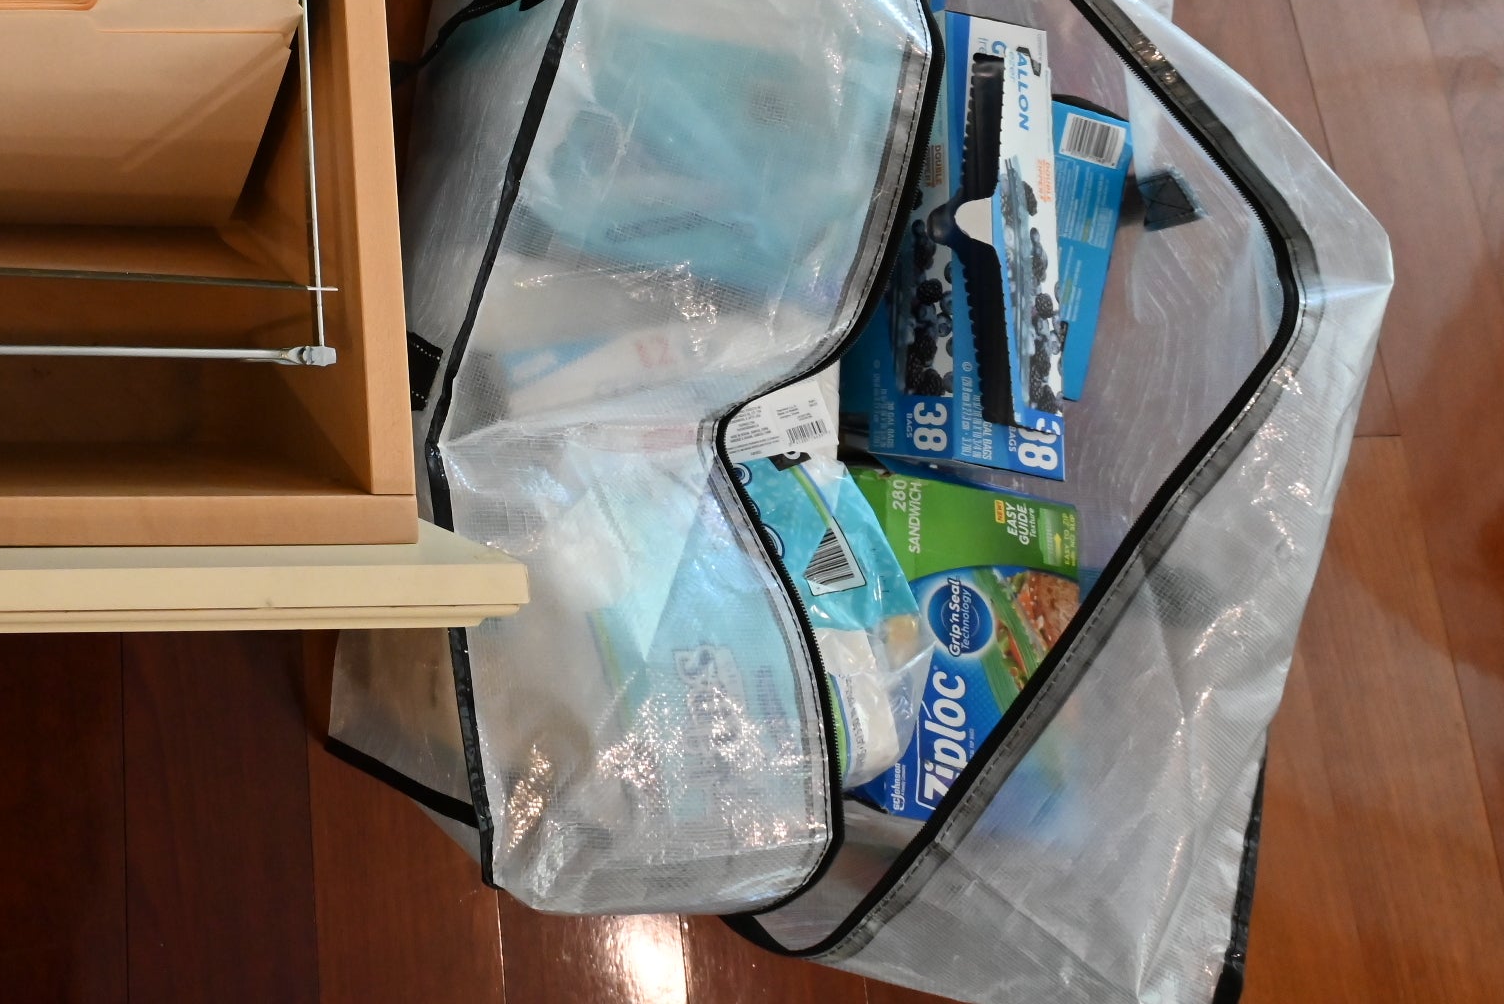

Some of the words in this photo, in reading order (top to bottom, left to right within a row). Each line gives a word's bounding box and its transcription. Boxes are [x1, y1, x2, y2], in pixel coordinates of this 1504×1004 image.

[905, 412, 914, 438] BAGS
[913, 402, 947, 452] 38
[983, 421, 992, 437] GAL
[1007, 426, 1017, 452] BAGS
[983, 438, 992, 460] BAGS
[893, 479, 907, 512] 280
[909, 481, 922, 554] SANDWICH
[1005, 501, 1017, 536] EASY
[1017, 504, 1030, 545] GUIDE
[1029, 507, 1037, 537] Texture
[948, 579, 960, 613] Seal
[960, 588, 972, 650] Technology
[948, 624, 962, 656] Grip
[924, 671, 968, 801] Ziploc
